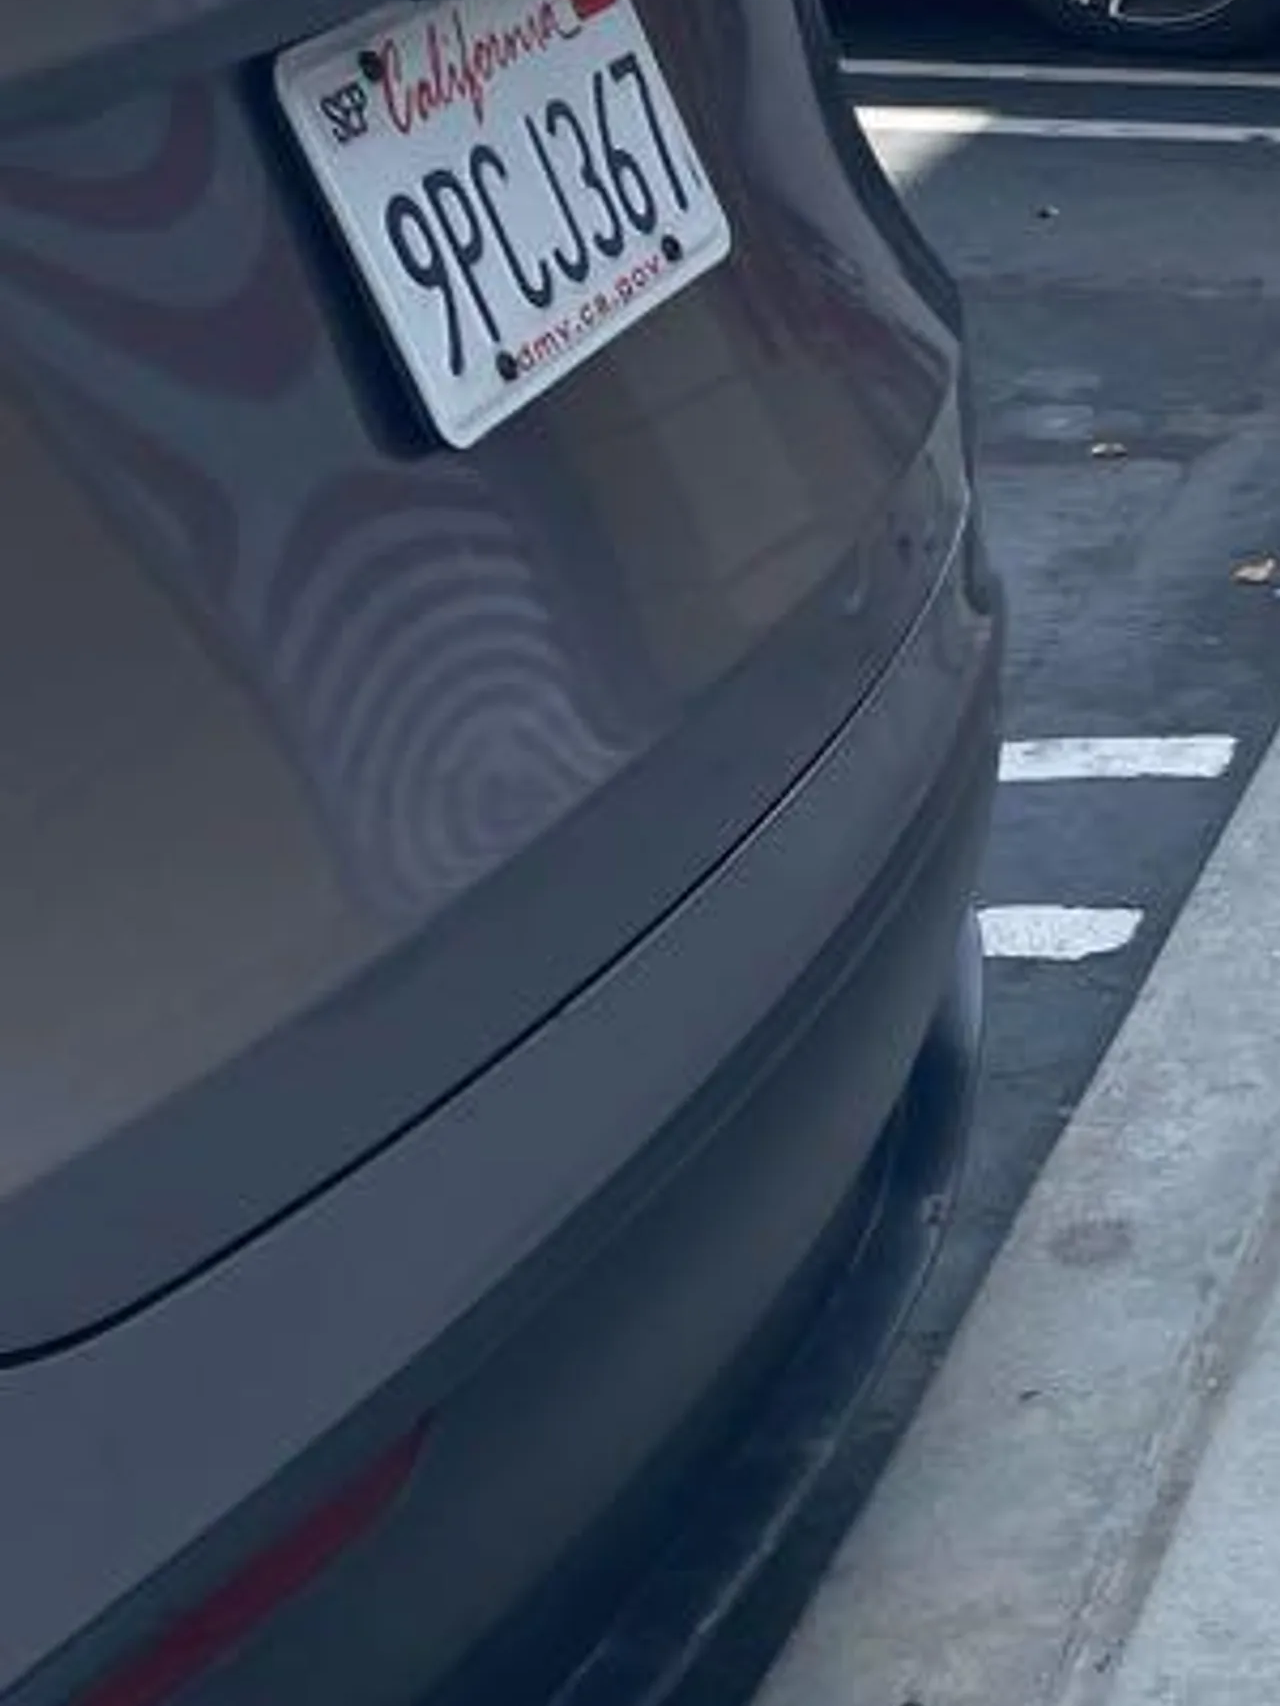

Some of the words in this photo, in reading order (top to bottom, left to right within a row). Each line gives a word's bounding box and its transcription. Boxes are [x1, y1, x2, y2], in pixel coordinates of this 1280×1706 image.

[320, 81, 368, 144] SEP
[379, 0, 583, 134] California
[384, 51, 688, 376] 9PCJ367
[517, 255, 661, 371] dmv.ca.gov
